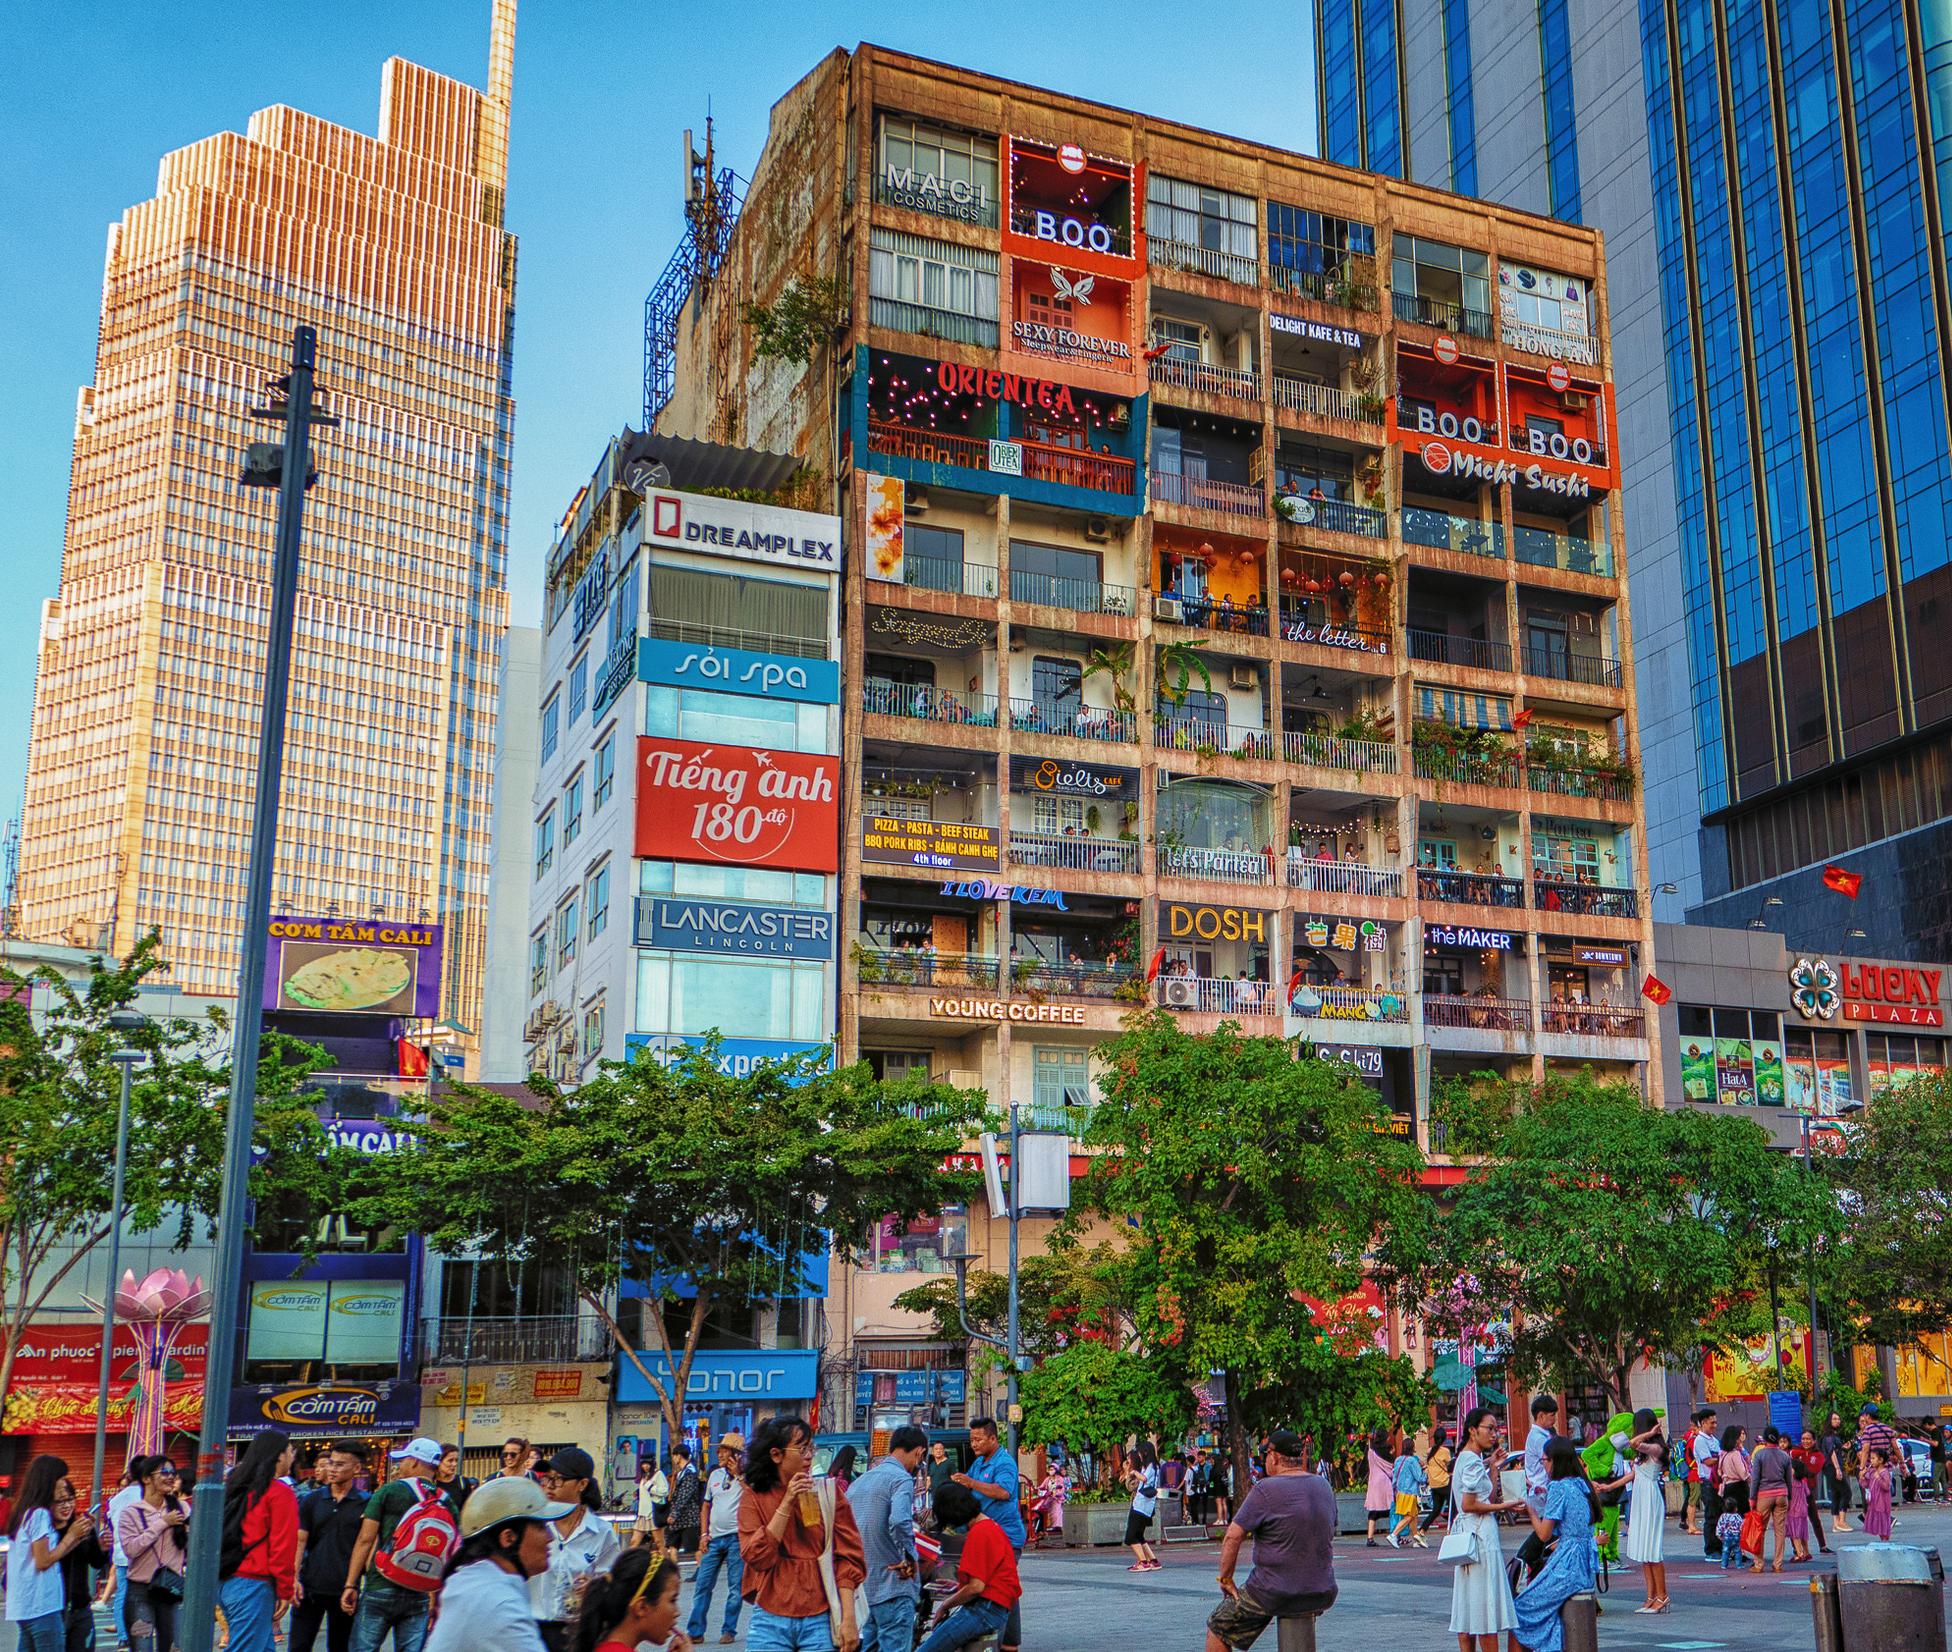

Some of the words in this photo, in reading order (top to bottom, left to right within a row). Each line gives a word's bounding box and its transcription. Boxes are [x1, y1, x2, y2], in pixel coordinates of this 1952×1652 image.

[894, 191, 979, 221] COSMETICS
[1036, 210, 1110, 252] BOO
[1014, 320, 1055, 342] SEXY
[1059, 330, 1131, 358] FOREVER
[1270, 315, 1306, 335] DELIGHT
[1309, 324, 1333, 341] KAFE
[1334, 330, 1341, 343] &
[1342, 331, 1360, 348] TEA
[938, 361, 1075, 414] ORIENTEA
[1418, 406, 1482, 443] BOO
[1529, 428, 1591, 463] BOO
[1453, 450, 1517, 485] Michi
[1525, 464, 1589, 497] Sushi
[685, 521, 833, 561] DREAMPLEX
[1287, 621, 1315, 641] the
[1320, 624, 1369, 651] letter
[740, 661, 807, 692] spa
[646, 749, 748, 804] Tiếng
[691, 802, 763, 844] 180
[765, 808, 787, 825] độ
[874, 818, 899, 833] PIZZA
[907, 821, 933, 836] PASTA
[941, 825, 961, 837] BEEF
[962, 827, 989, 840] STEAK
[865, 834, 882, 848] BBQ
[883, 837, 906, 850] PORK
[908, 839, 927, 852] RIBS
[934, 839, 957, 855] BÁNH
[958, 843, 981, 857] CANH
[913, 854, 929, 865] 4th
[931, 855, 952, 866] floor
[940, 880, 954, 896] I
[957, 878, 1011, 900] LOVE
[1011, 886, 1069, 911] KEM
[268, 922, 322, 940] CƠM
[326, 920, 375, 942] TẤM
[379, 929, 432, 945] CALI
[661, 904, 829, 940] LANCASTER
[1170, 906, 1264, 942] DOSH
[1305, 921, 1387, 952] 芒果樹
[694, 937, 793, 951] LINCOLN
[1432, 928, 1455, 945] the
[1458, 930, 1510, 949] MAKER
[1840, 963, 1942, 1005] LUCKY
[932, 999, 1003, 1018] YOUNG
[1009, 1004, 1085, 1023] COFFEE
[1852, 1004, 1936, 1024] PLAZA
[50, 1344, 95, 1361] phuoc
[168, 1344, 205, 1356] ardin
[337, 1414, 375, 1425] CALI
